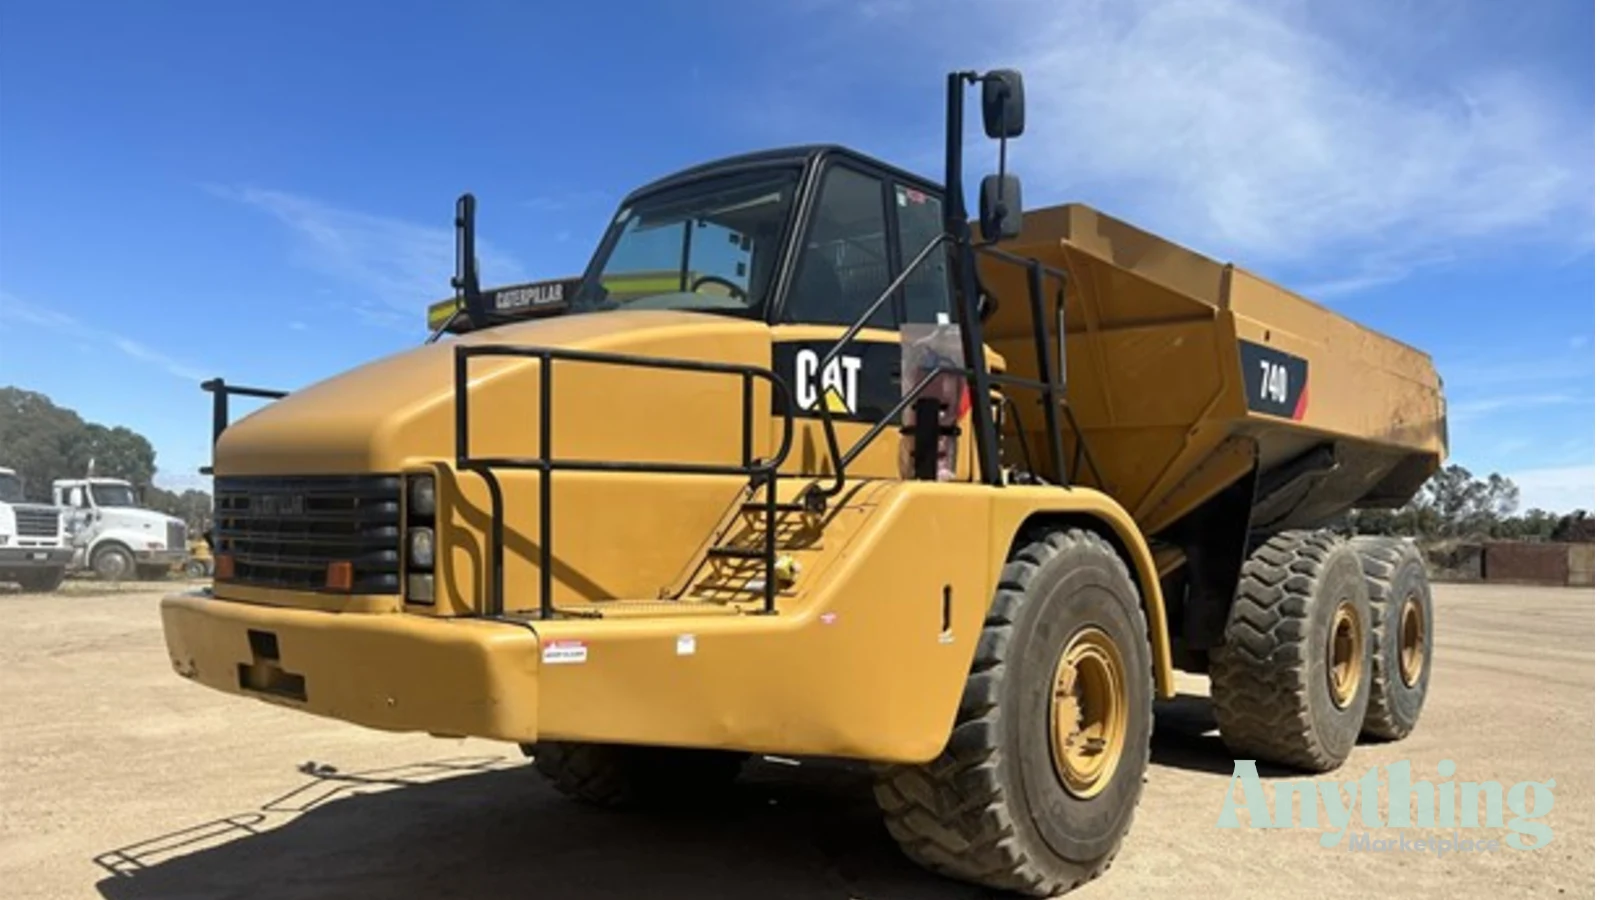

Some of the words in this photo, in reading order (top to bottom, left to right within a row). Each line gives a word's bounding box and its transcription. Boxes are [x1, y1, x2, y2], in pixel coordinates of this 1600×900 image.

[496, 283, 563, 309] CATERPILLAR
[796, 348, 861, 415] CAT
[1260, 360, 1288, 403] 740
